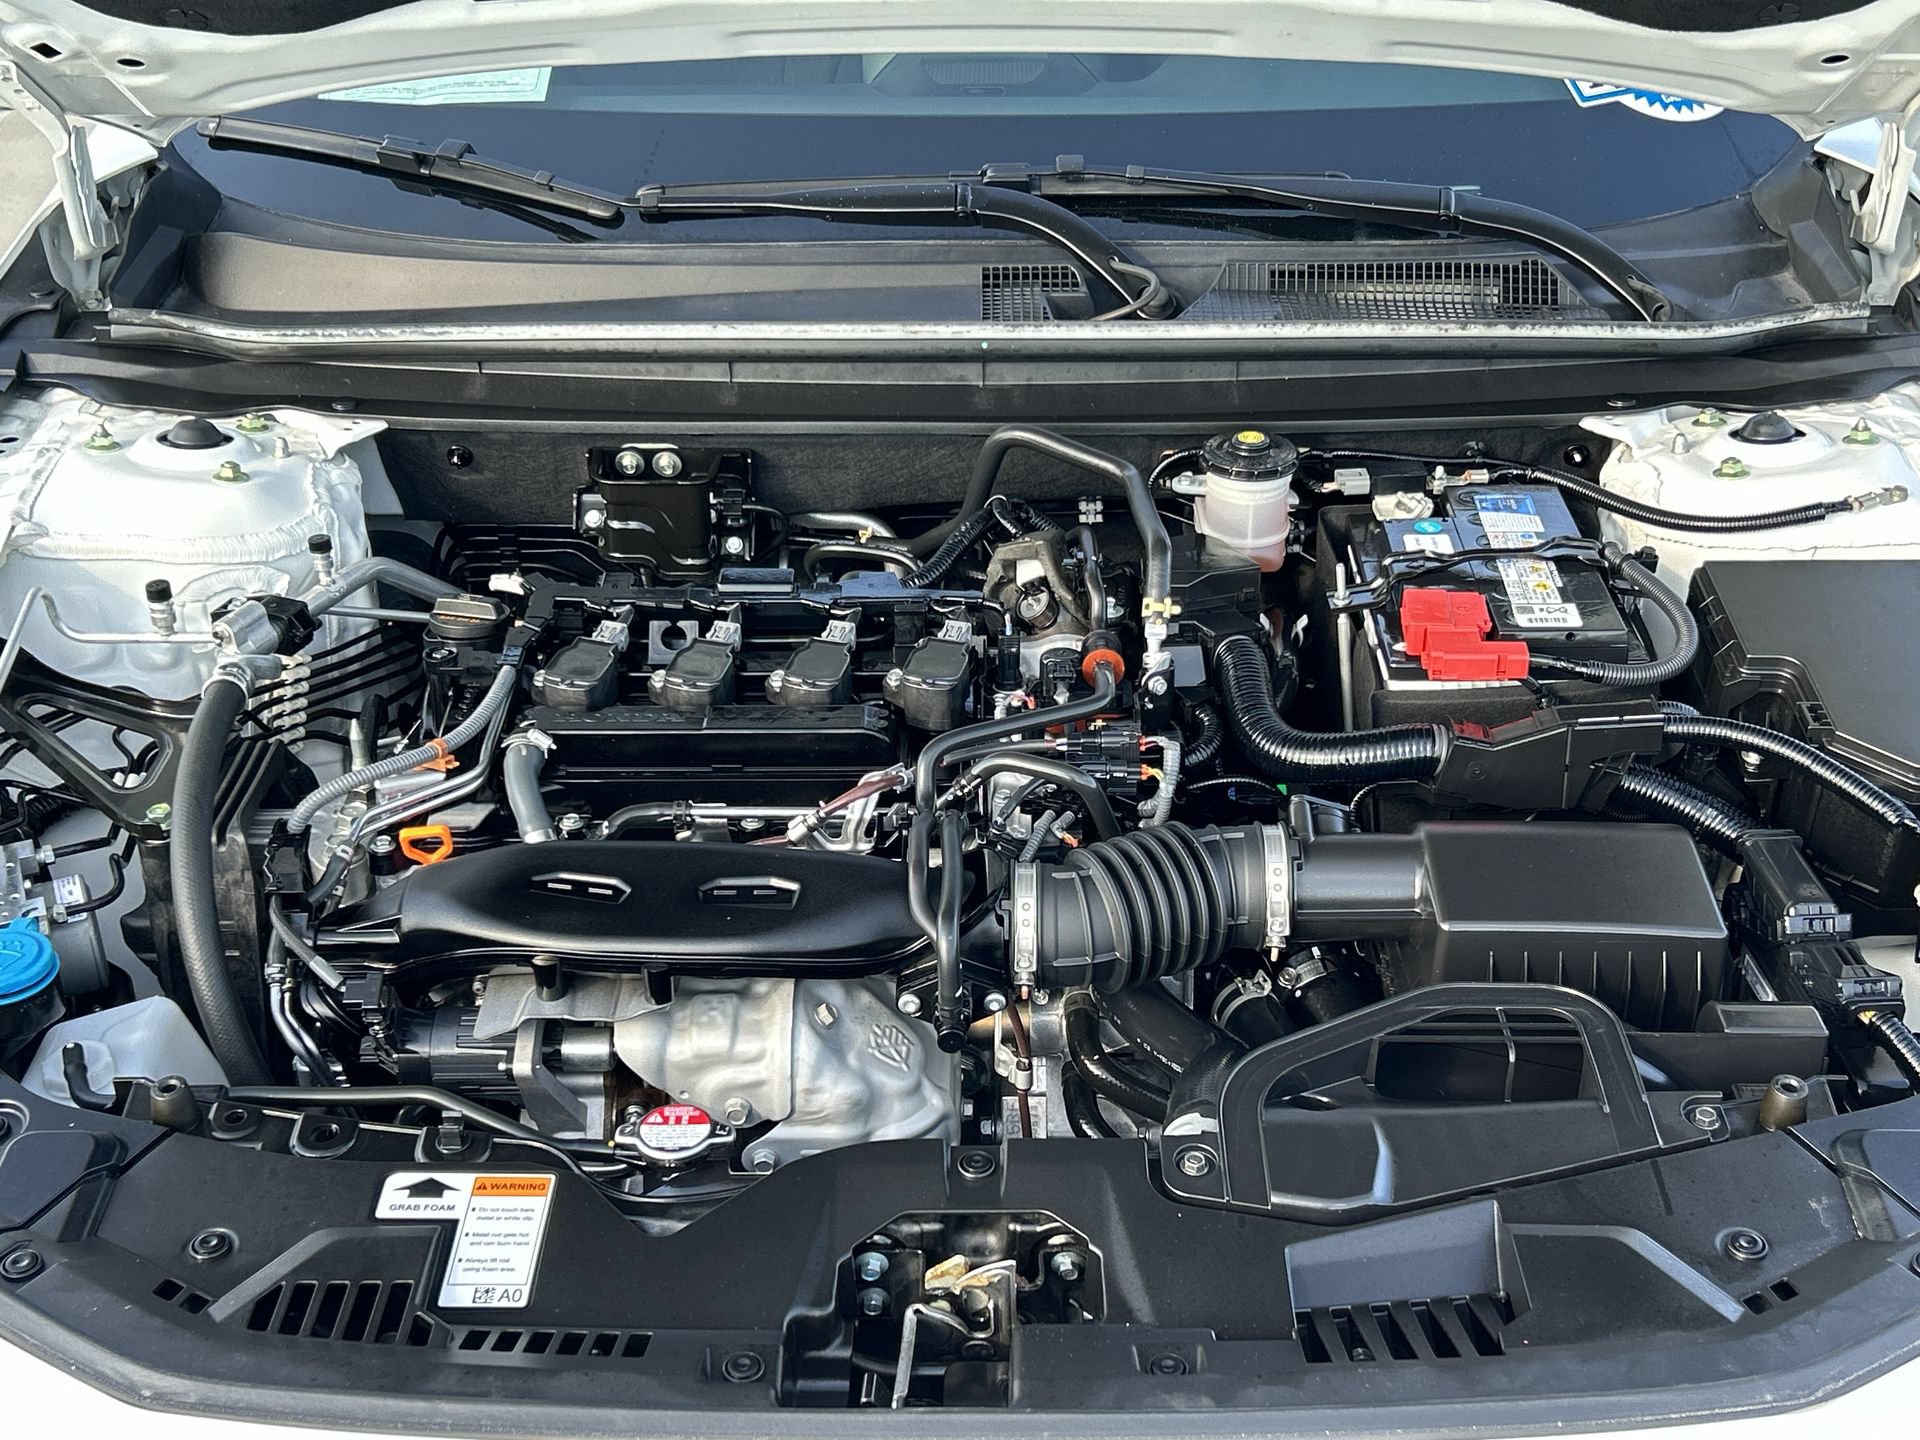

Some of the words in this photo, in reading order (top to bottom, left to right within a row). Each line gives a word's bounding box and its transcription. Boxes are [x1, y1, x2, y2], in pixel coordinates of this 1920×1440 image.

[490, 1182, 547, 1191] WARNING
[389, 1203, 421, 1212] GRAB
[423, 1203, 456, 1212] FOAM
[497, 1288, 523, 1303] A0
